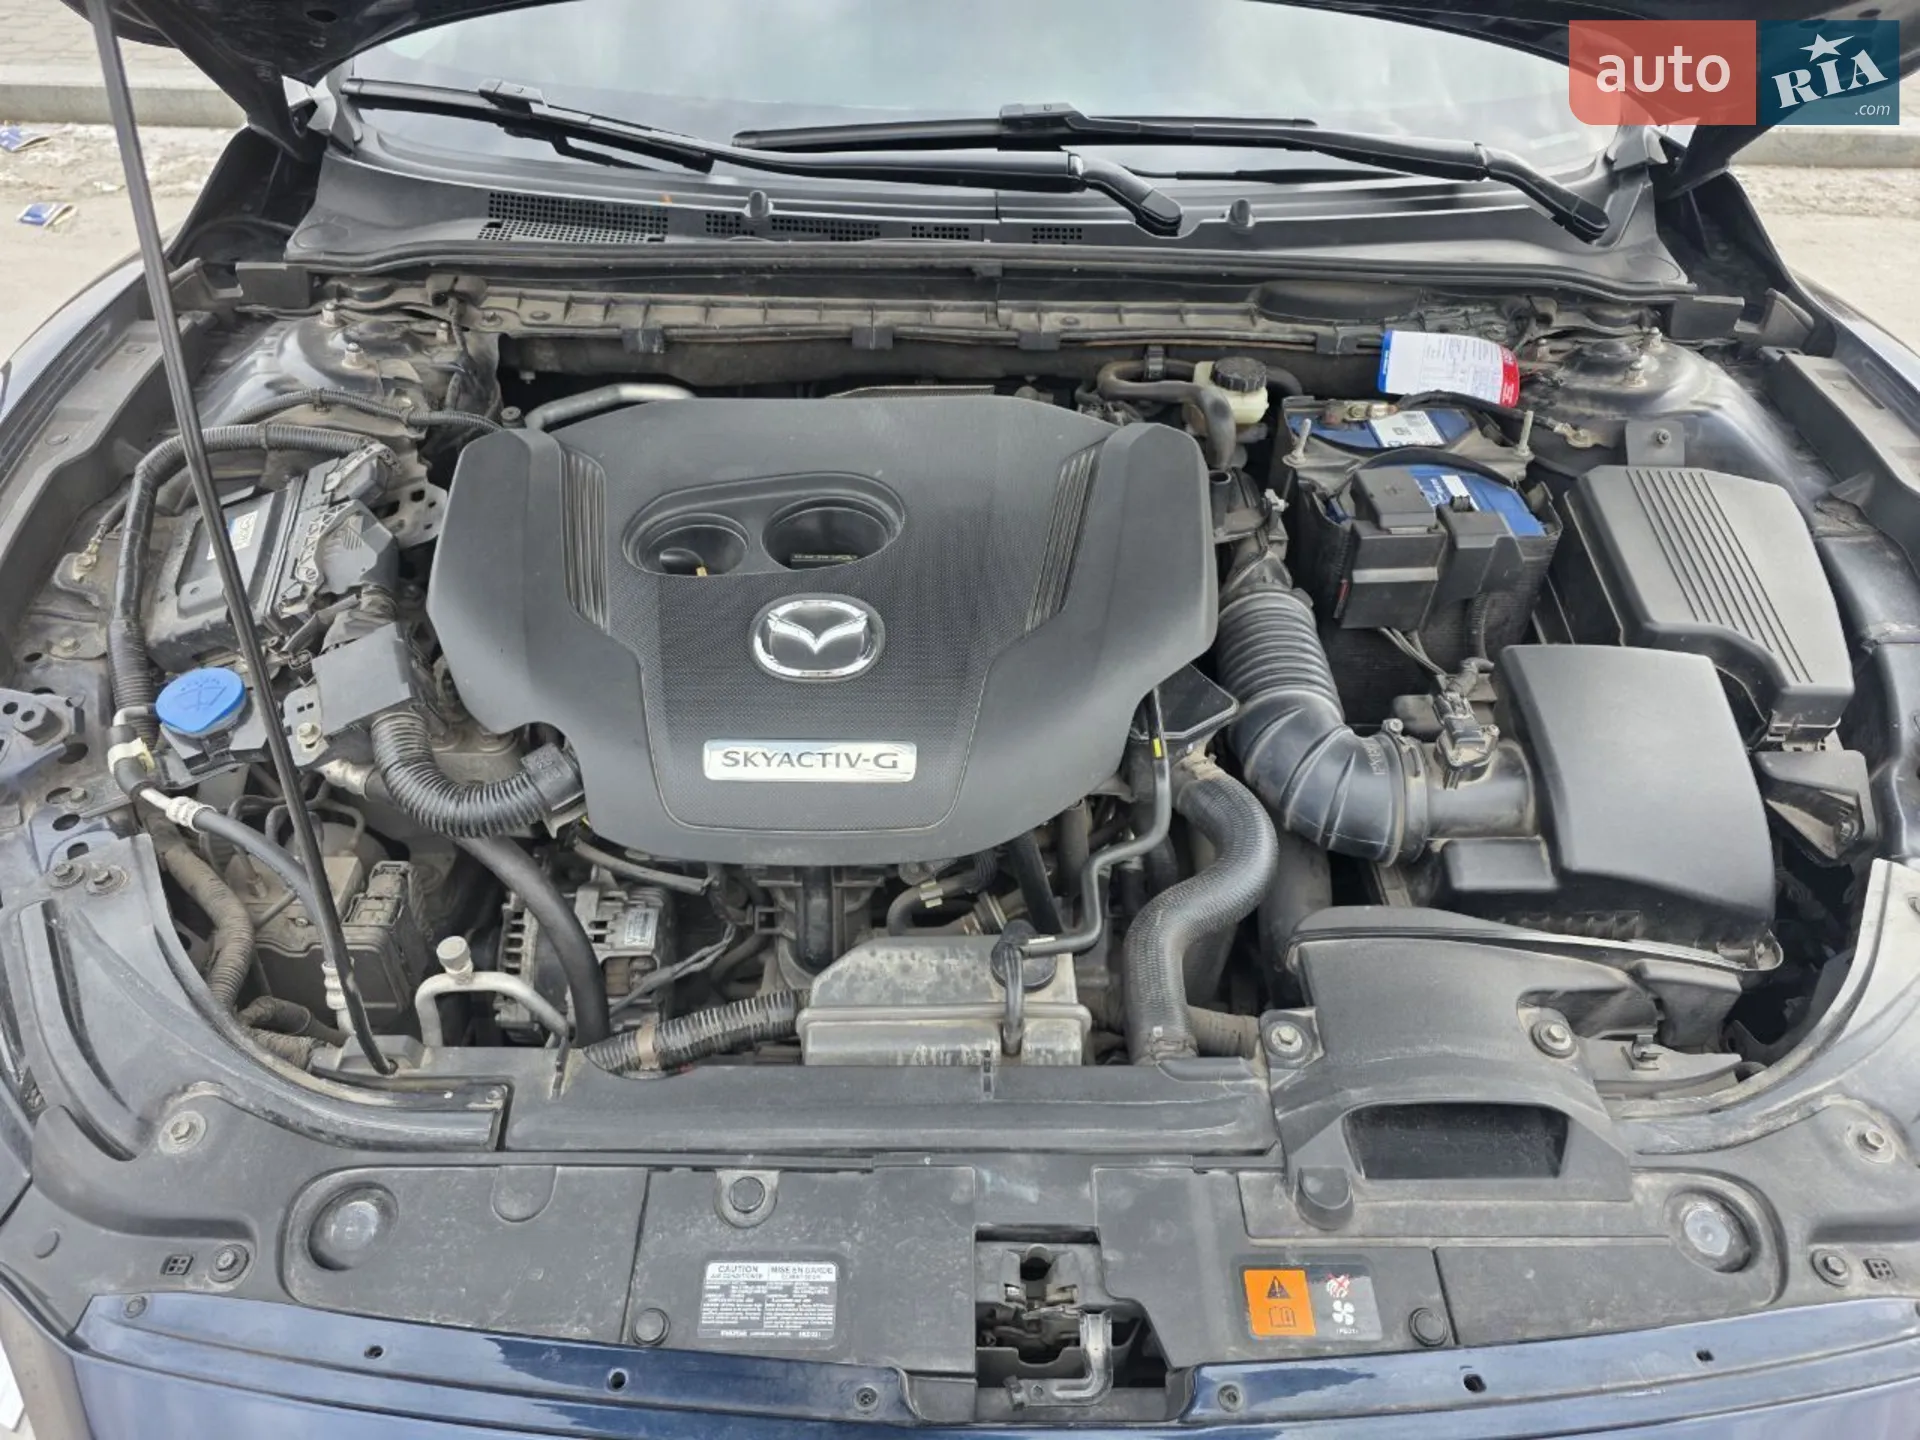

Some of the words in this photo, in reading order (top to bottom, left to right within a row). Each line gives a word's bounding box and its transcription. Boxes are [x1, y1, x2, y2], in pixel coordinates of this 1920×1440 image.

[721, 750, 899, 769] SKYACTIV-G
[717, 1265, 759, 1274] CAUTION
[770, 1266, 790, 1274] MISE
[792, 1266, 803, 1274] EN
[805, 1266, 834, 1275] GARDE
